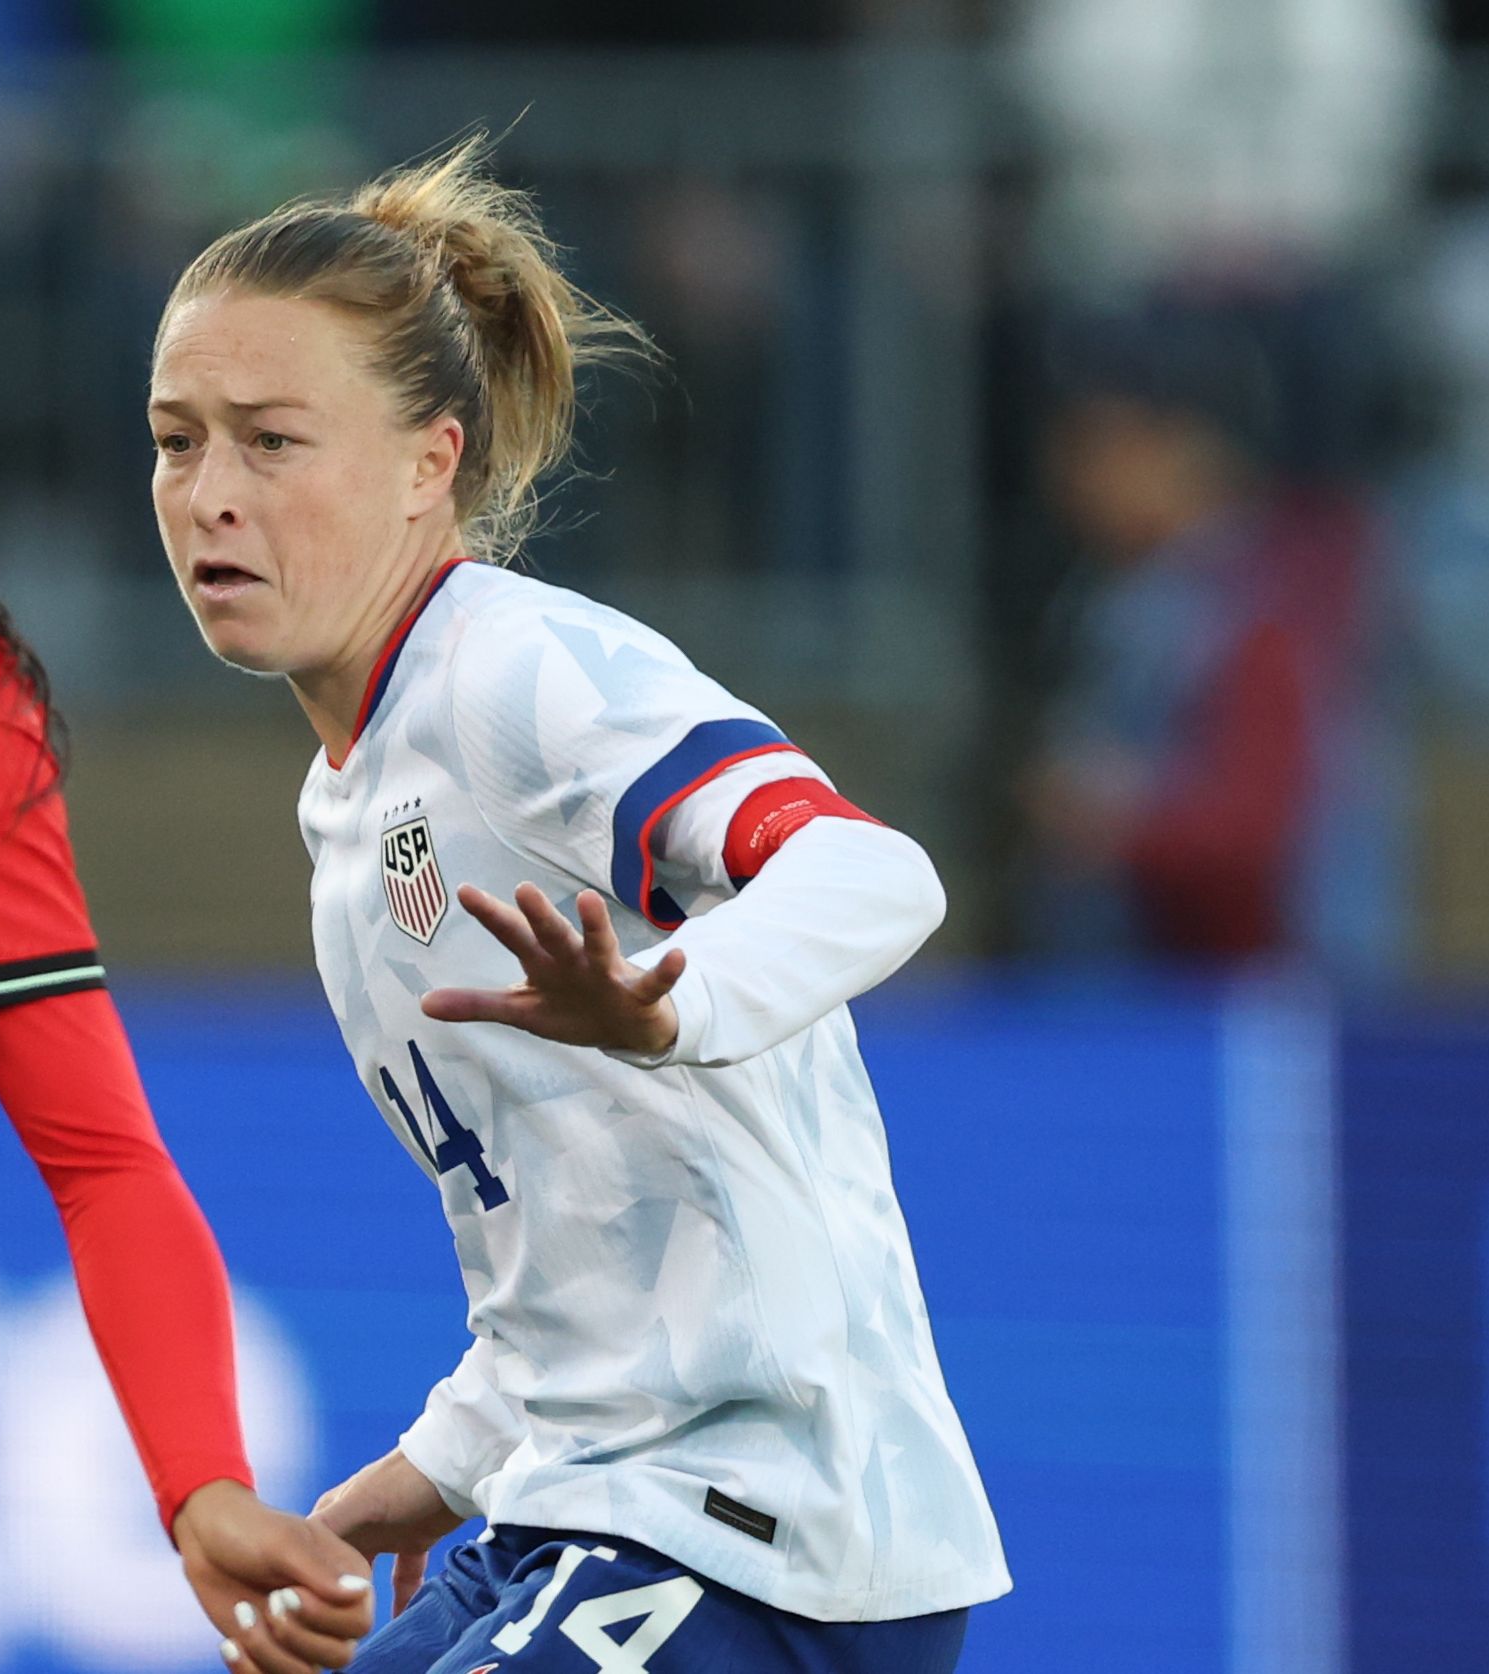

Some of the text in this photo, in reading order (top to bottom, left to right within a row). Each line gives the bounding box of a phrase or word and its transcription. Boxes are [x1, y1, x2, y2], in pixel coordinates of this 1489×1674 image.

[384, 825, 429, 877] USA
[750, 822, 764, 848] OCT
[379, 1038, 511, 1212] 14
[490, 1543, 705, 1674] 14
